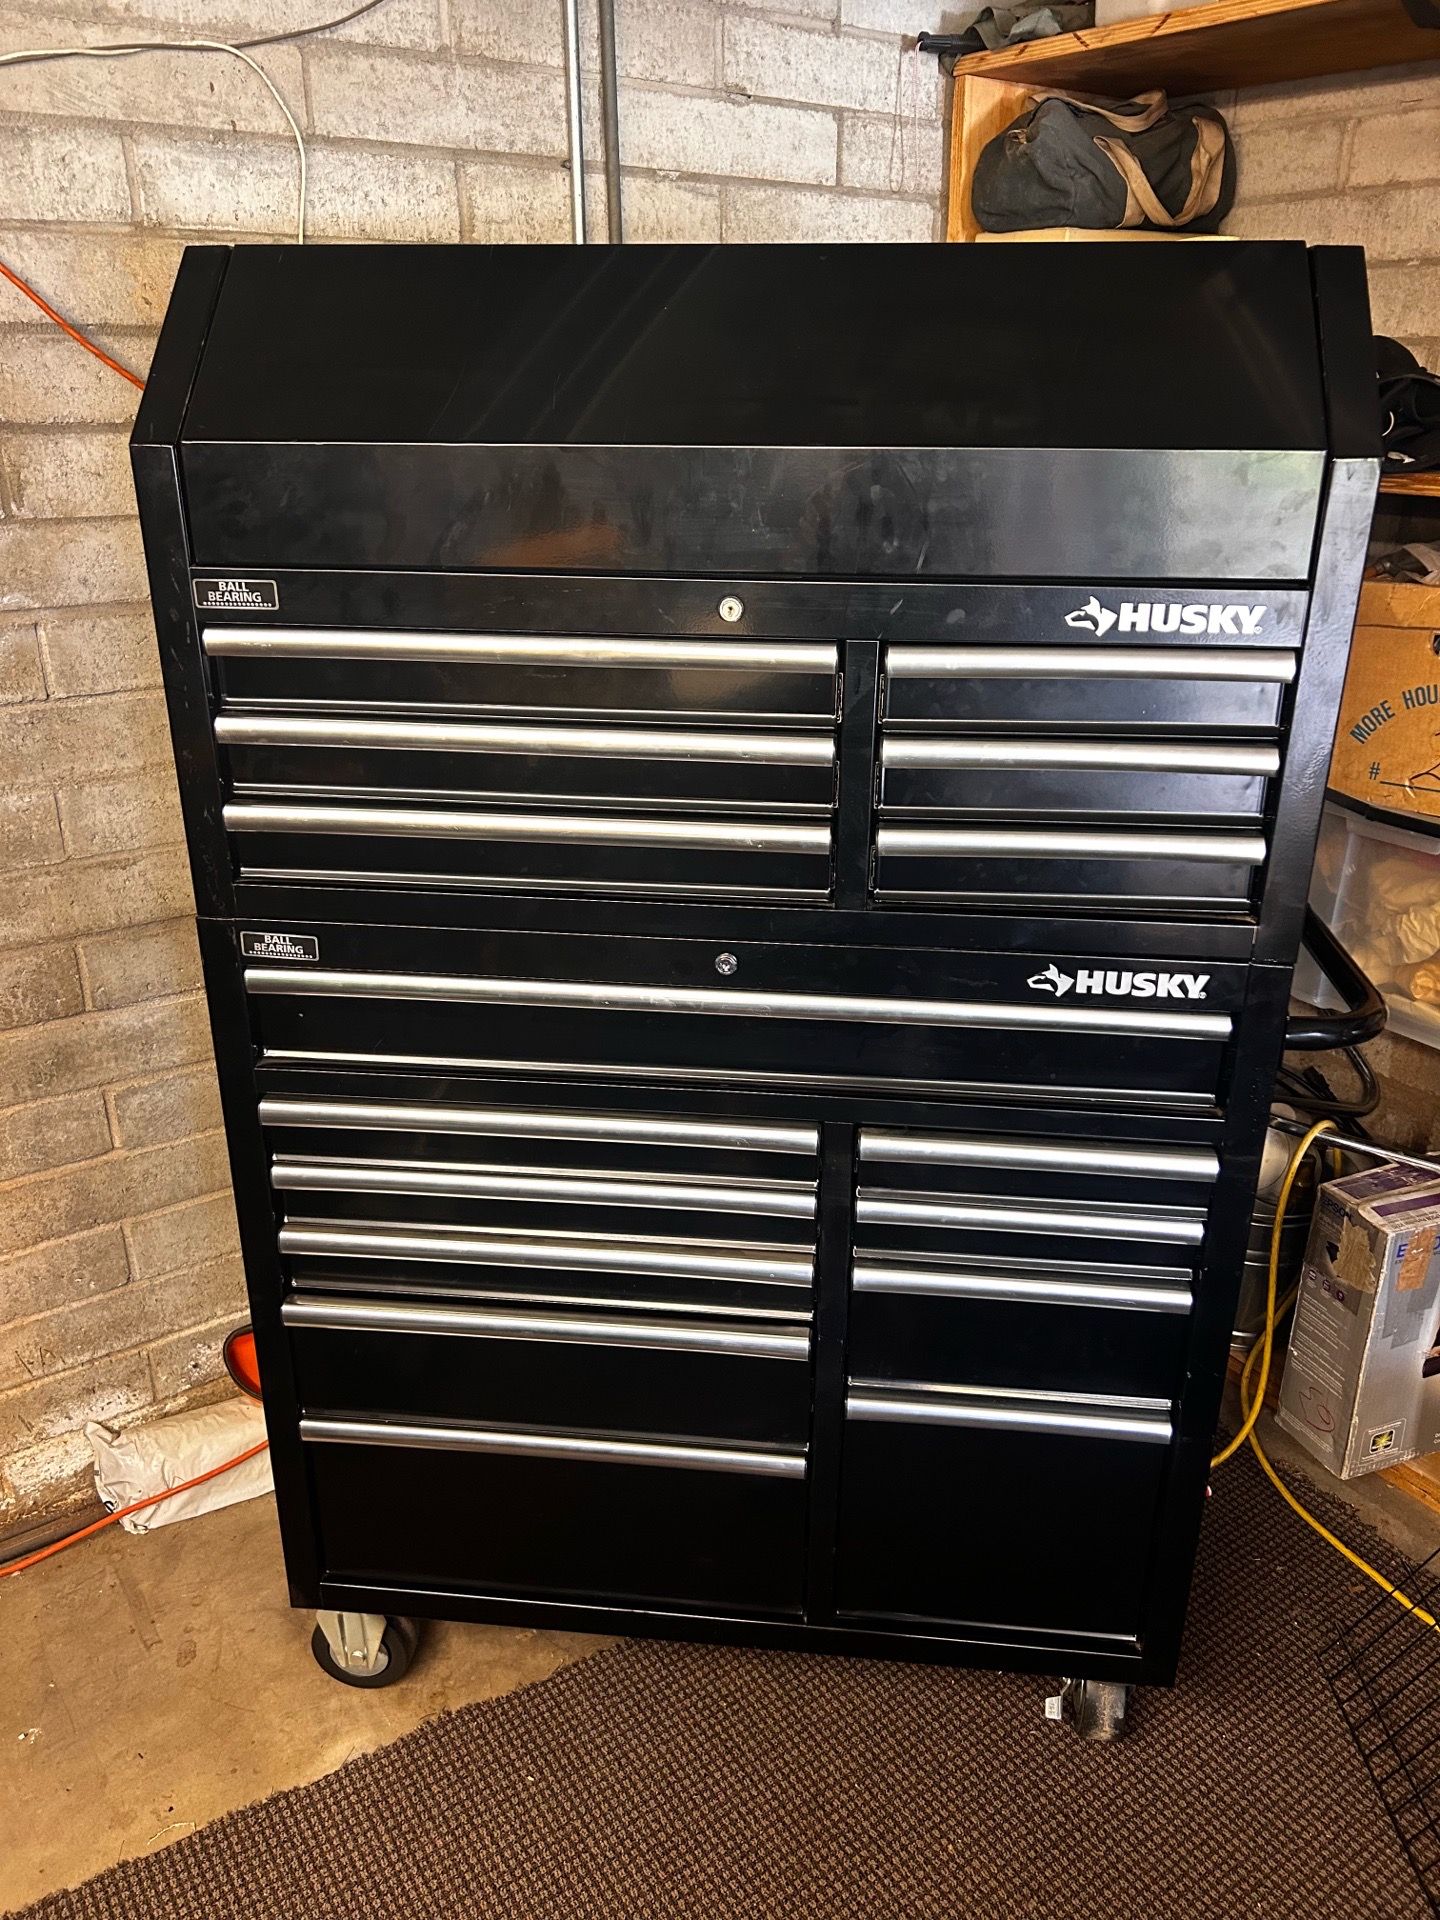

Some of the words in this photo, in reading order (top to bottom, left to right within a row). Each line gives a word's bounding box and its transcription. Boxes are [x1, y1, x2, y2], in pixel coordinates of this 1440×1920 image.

[218, 581, 249, 592] BALL
[207, 591, 262, 603] BEARING
[1117, 602, 1268, 635] HUSKY
[1349, 699, 1396, 745] MORE
[264, 934, 292, 945] BALL
[253, 942, 304, 954] BEARING
[1075, 969, 1211, 999] HUSKY
